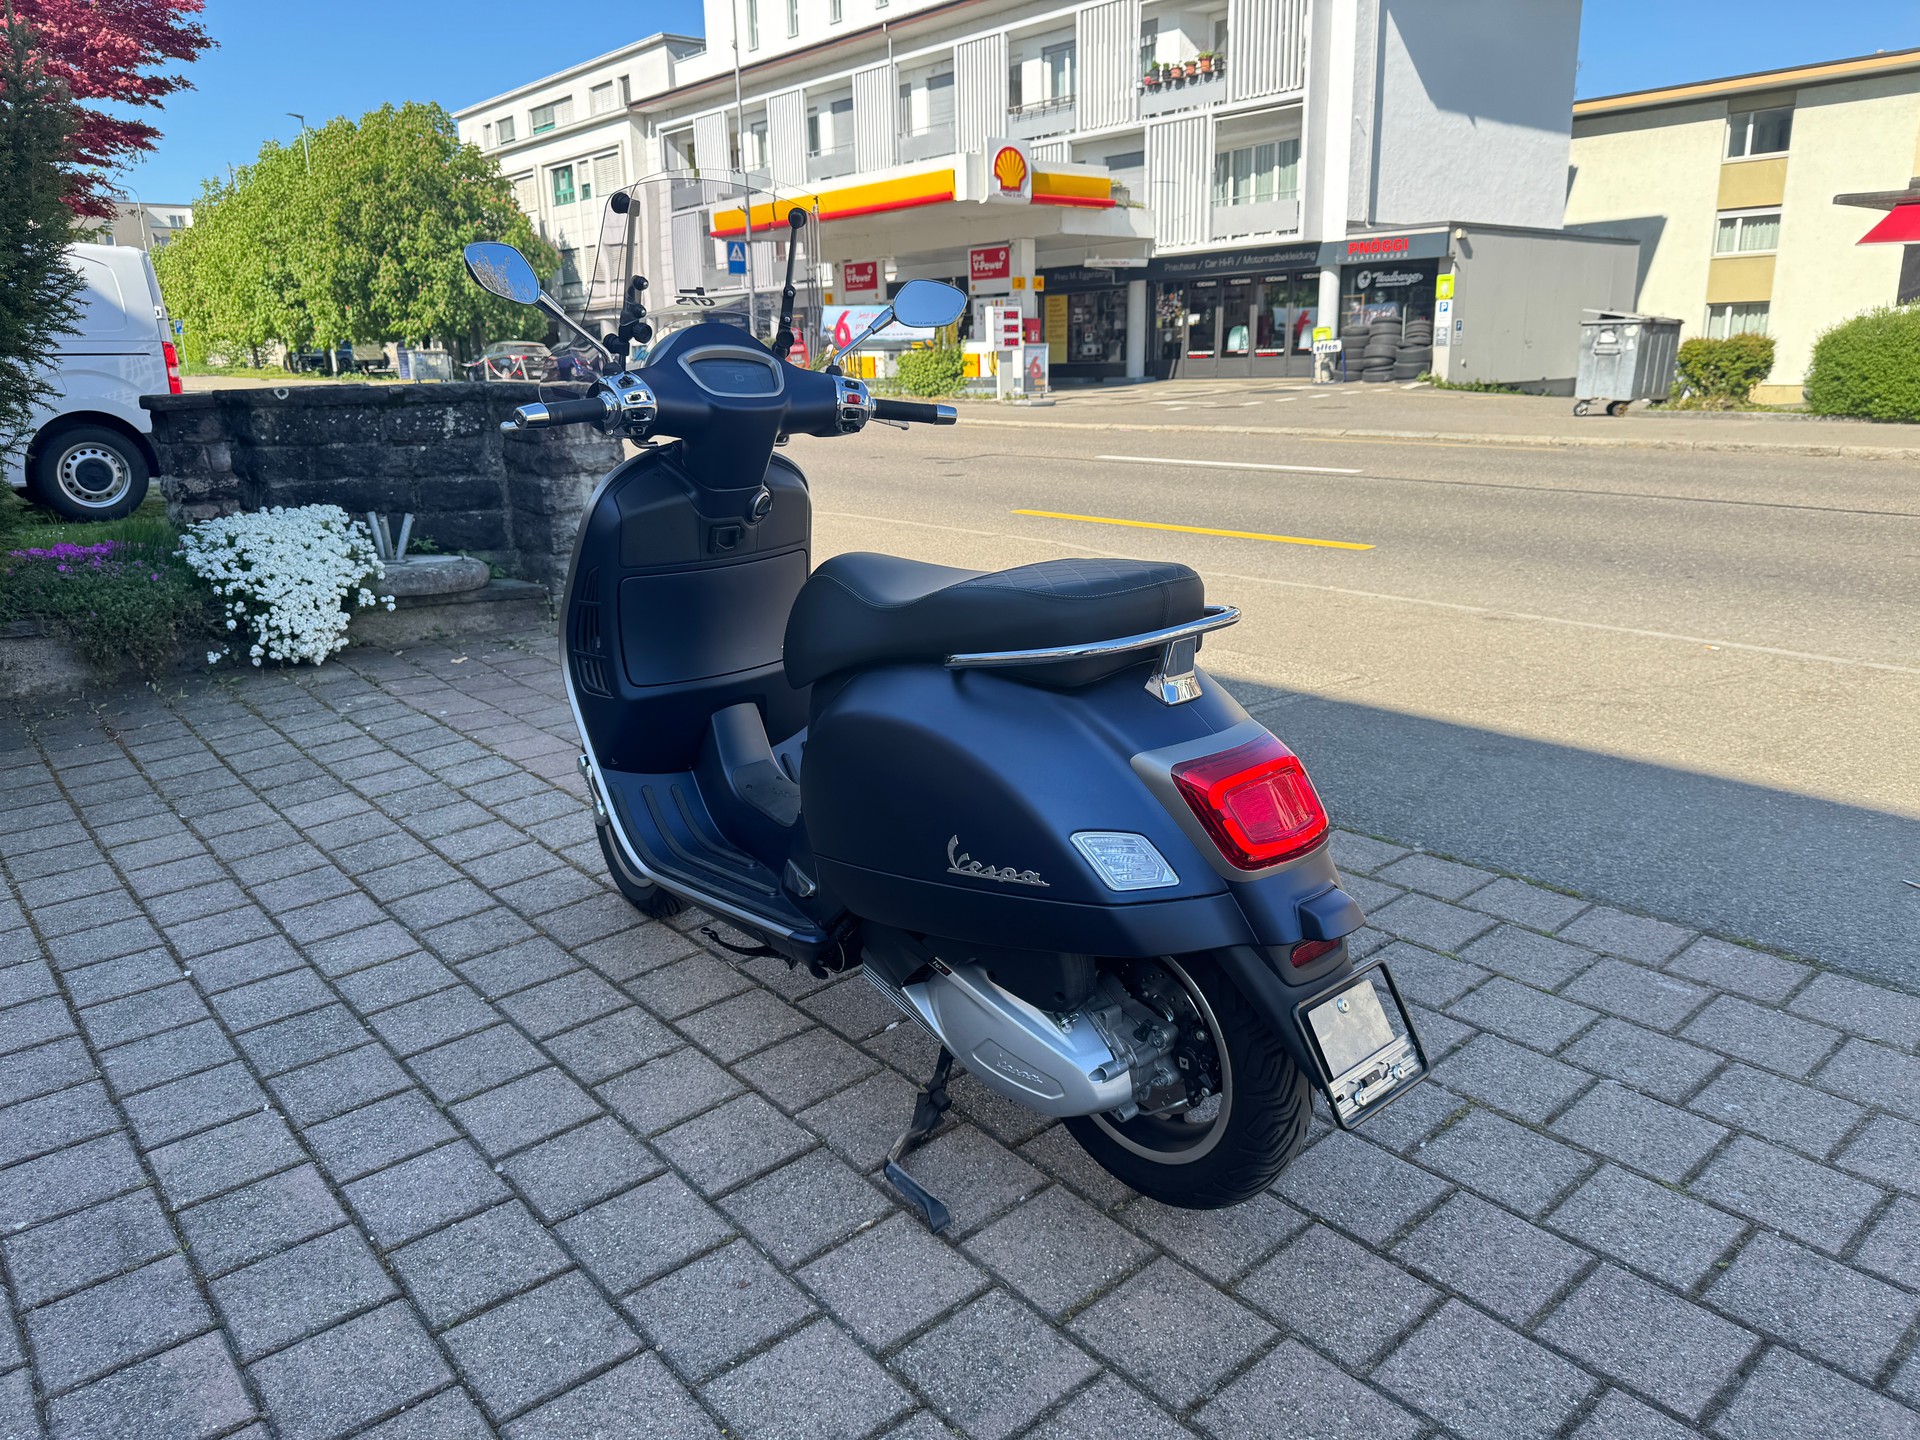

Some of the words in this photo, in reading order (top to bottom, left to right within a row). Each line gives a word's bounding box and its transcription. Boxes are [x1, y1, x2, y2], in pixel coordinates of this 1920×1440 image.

[1164, 261, 1197, 273] Pneuhaus
[1204, 258, 1218, 268] Car
[1243, 250, 1317, 265] Motorradbekleidung
[834, 310, 852, 348] 6
[1030, 356, 1042, 379] 6
[947, 834, 1051, 887] Vespa
[996, 1053, 1044, 1084] Vespa
